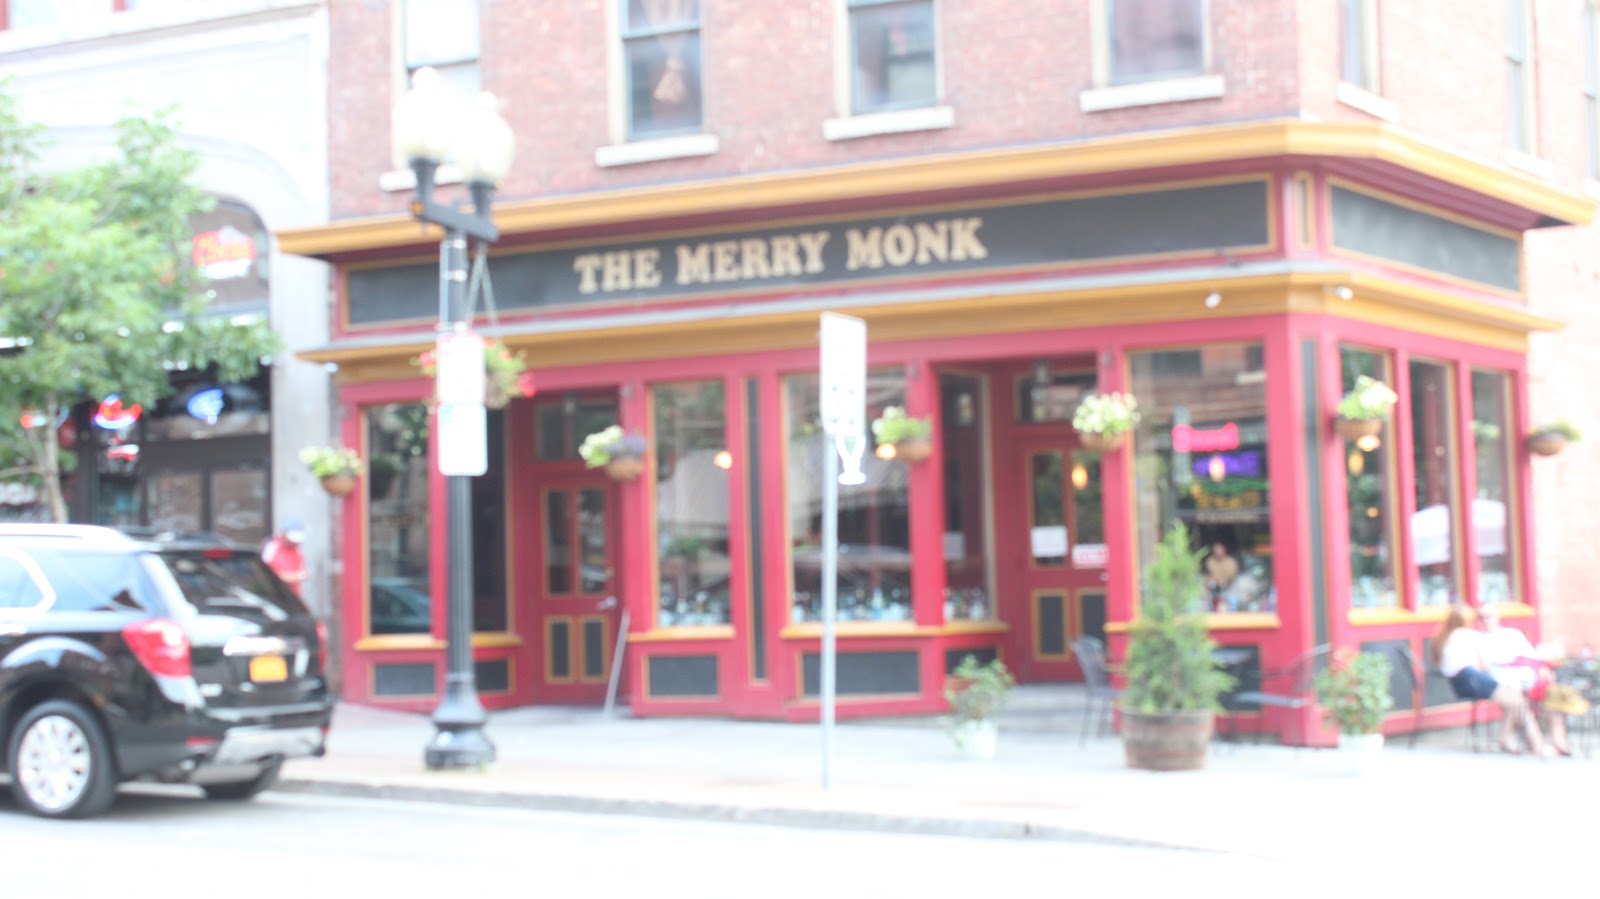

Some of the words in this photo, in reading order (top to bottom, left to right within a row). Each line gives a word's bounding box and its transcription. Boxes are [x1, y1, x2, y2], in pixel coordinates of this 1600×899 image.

[573, 248, 662, 294] THE
[676, 232, 830, 285] MERRY
[846, 217, 988, 271] MONK
